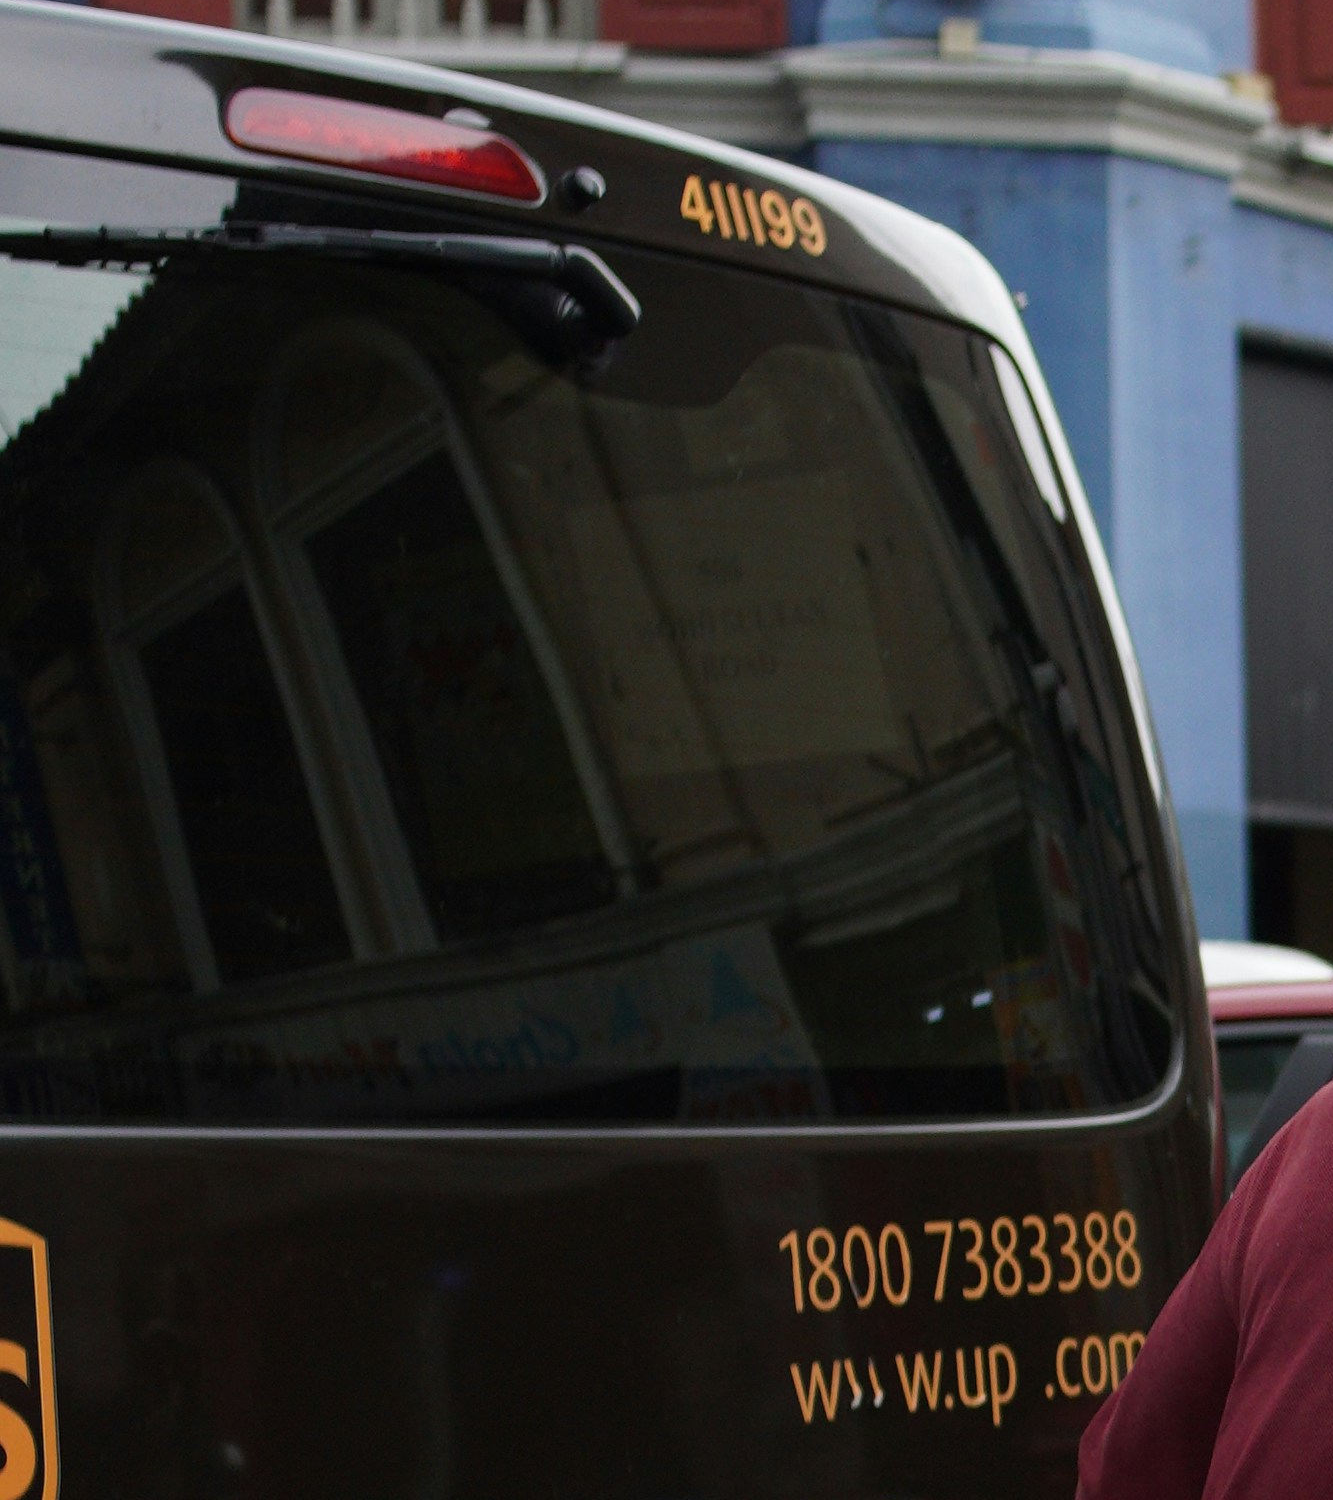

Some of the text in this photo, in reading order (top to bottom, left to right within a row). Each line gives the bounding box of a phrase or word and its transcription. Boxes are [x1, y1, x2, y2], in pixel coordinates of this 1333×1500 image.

[679, 173, 828, 258] 411199
[778, 1208, 1143, 1314] 1800 7383388
